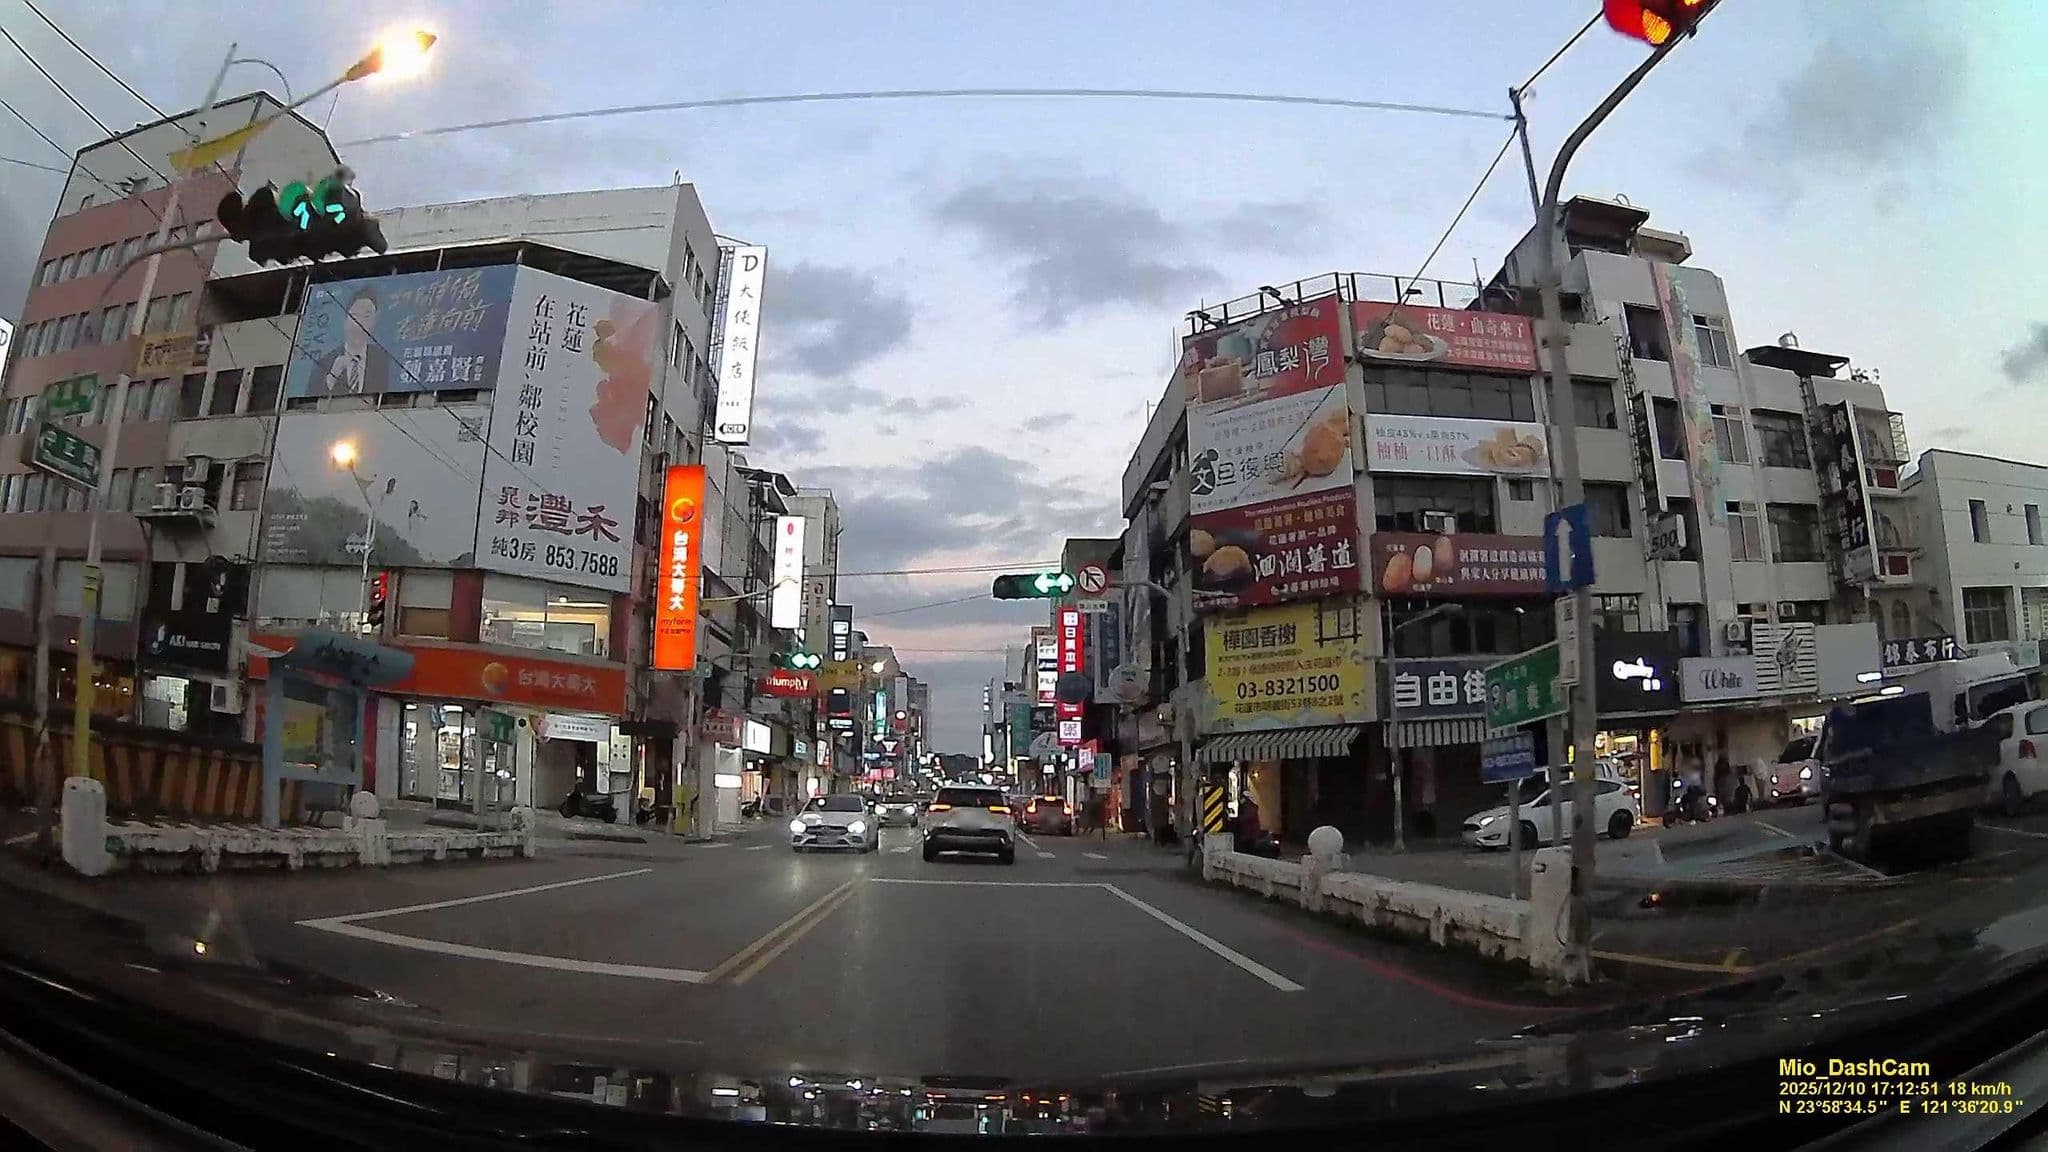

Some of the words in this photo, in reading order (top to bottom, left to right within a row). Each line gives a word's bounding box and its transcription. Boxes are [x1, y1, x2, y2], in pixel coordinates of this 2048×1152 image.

[561, 302, 588, 353] 花蓮
[512, 294, 556, 467] 在站前、鄰校園
[1256, 336, 1329, 382] 鳳梨灣
[490, 536, 536, 561] 純3房
[545, 544, 618, 577] 853.7588
[1236, 673, 1340, 699] 03-8321500
